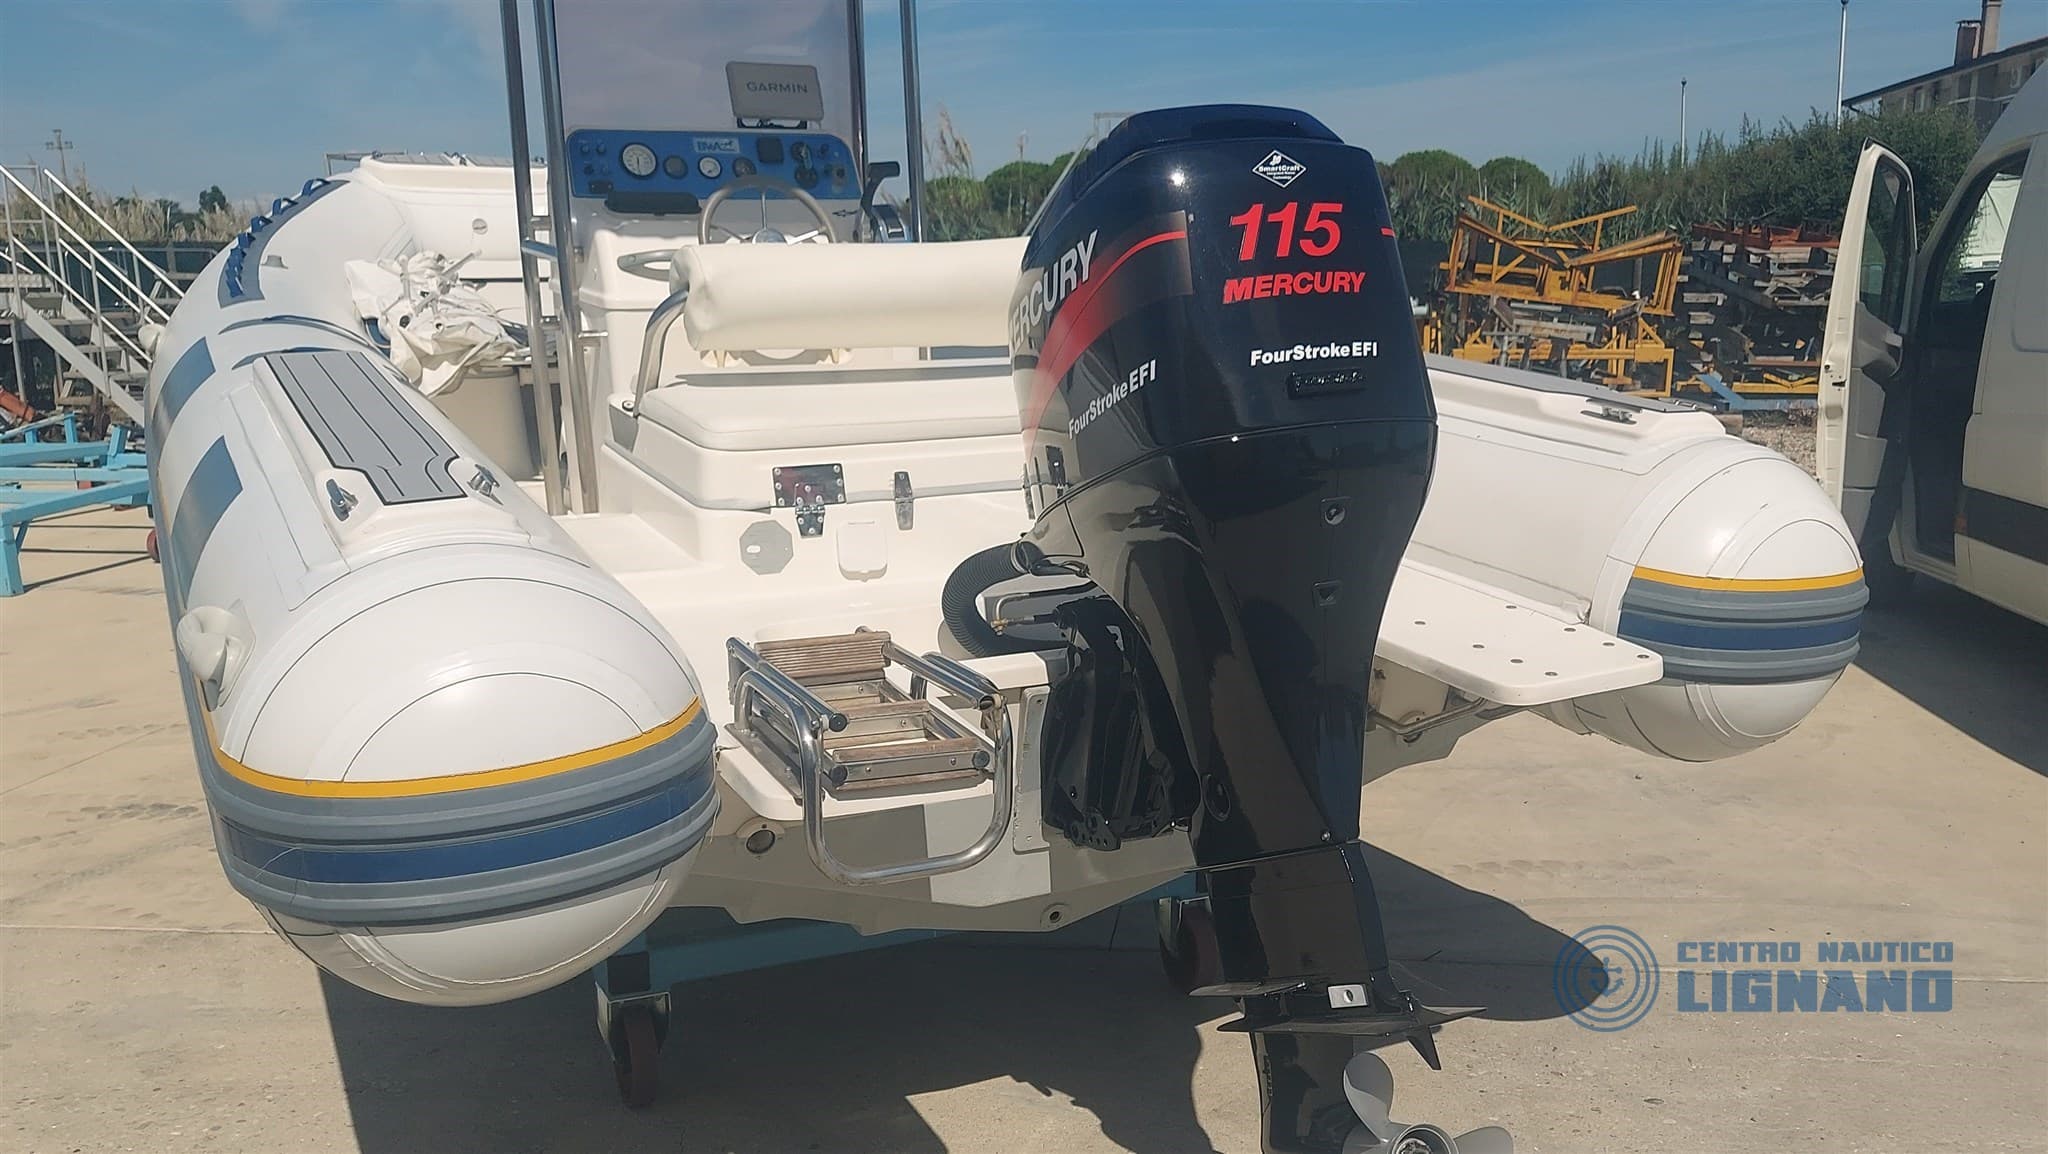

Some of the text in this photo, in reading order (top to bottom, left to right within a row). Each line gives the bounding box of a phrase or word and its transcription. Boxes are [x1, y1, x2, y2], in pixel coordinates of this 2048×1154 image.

[746, 81, 808, 94] GARMIN
[1231, 202, 1343, 261] 115
[1009, 229, 1098, 356] ERCURY
[1223, 271, 1366, 304] MERCURY
